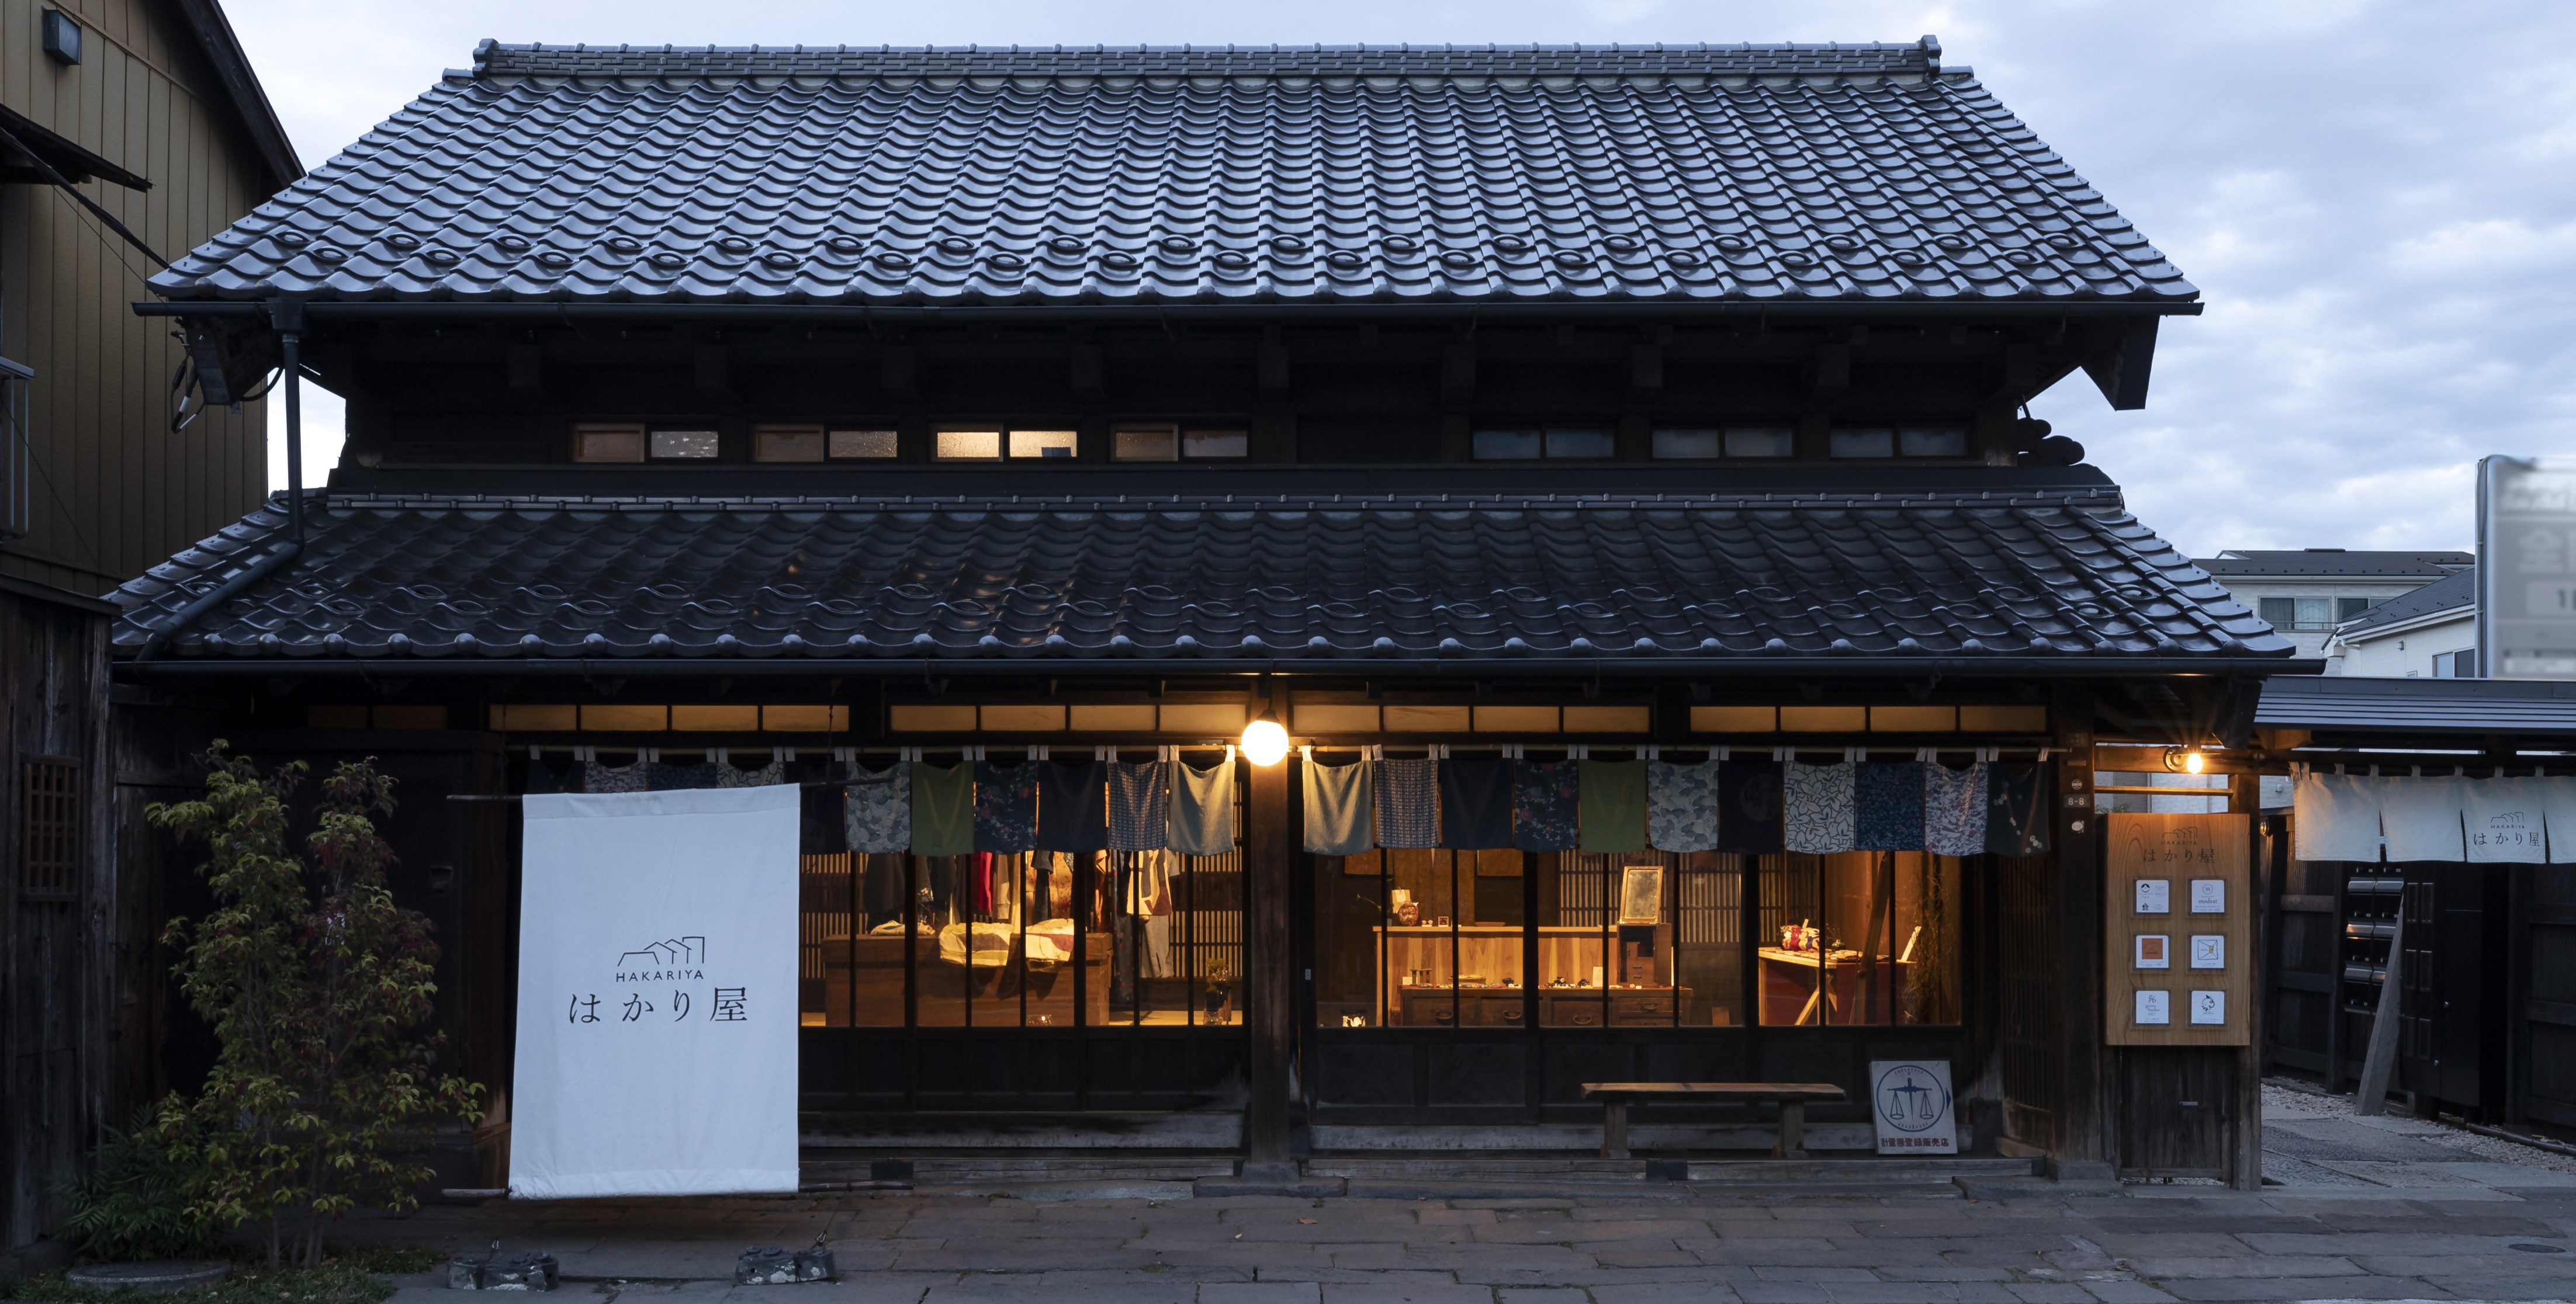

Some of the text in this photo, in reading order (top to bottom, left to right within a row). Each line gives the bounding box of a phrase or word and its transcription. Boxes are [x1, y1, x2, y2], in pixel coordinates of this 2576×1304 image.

[2473, 832, 2540, 847] はかり屋
[2144, 848, 2215, 863] はかり屋
[616, 970, 704, 982] HAKARIYA
[569, 987, 747, 1024] はかり屋
[1881, 1137, 1950, 1147] 計量器登録販売店
